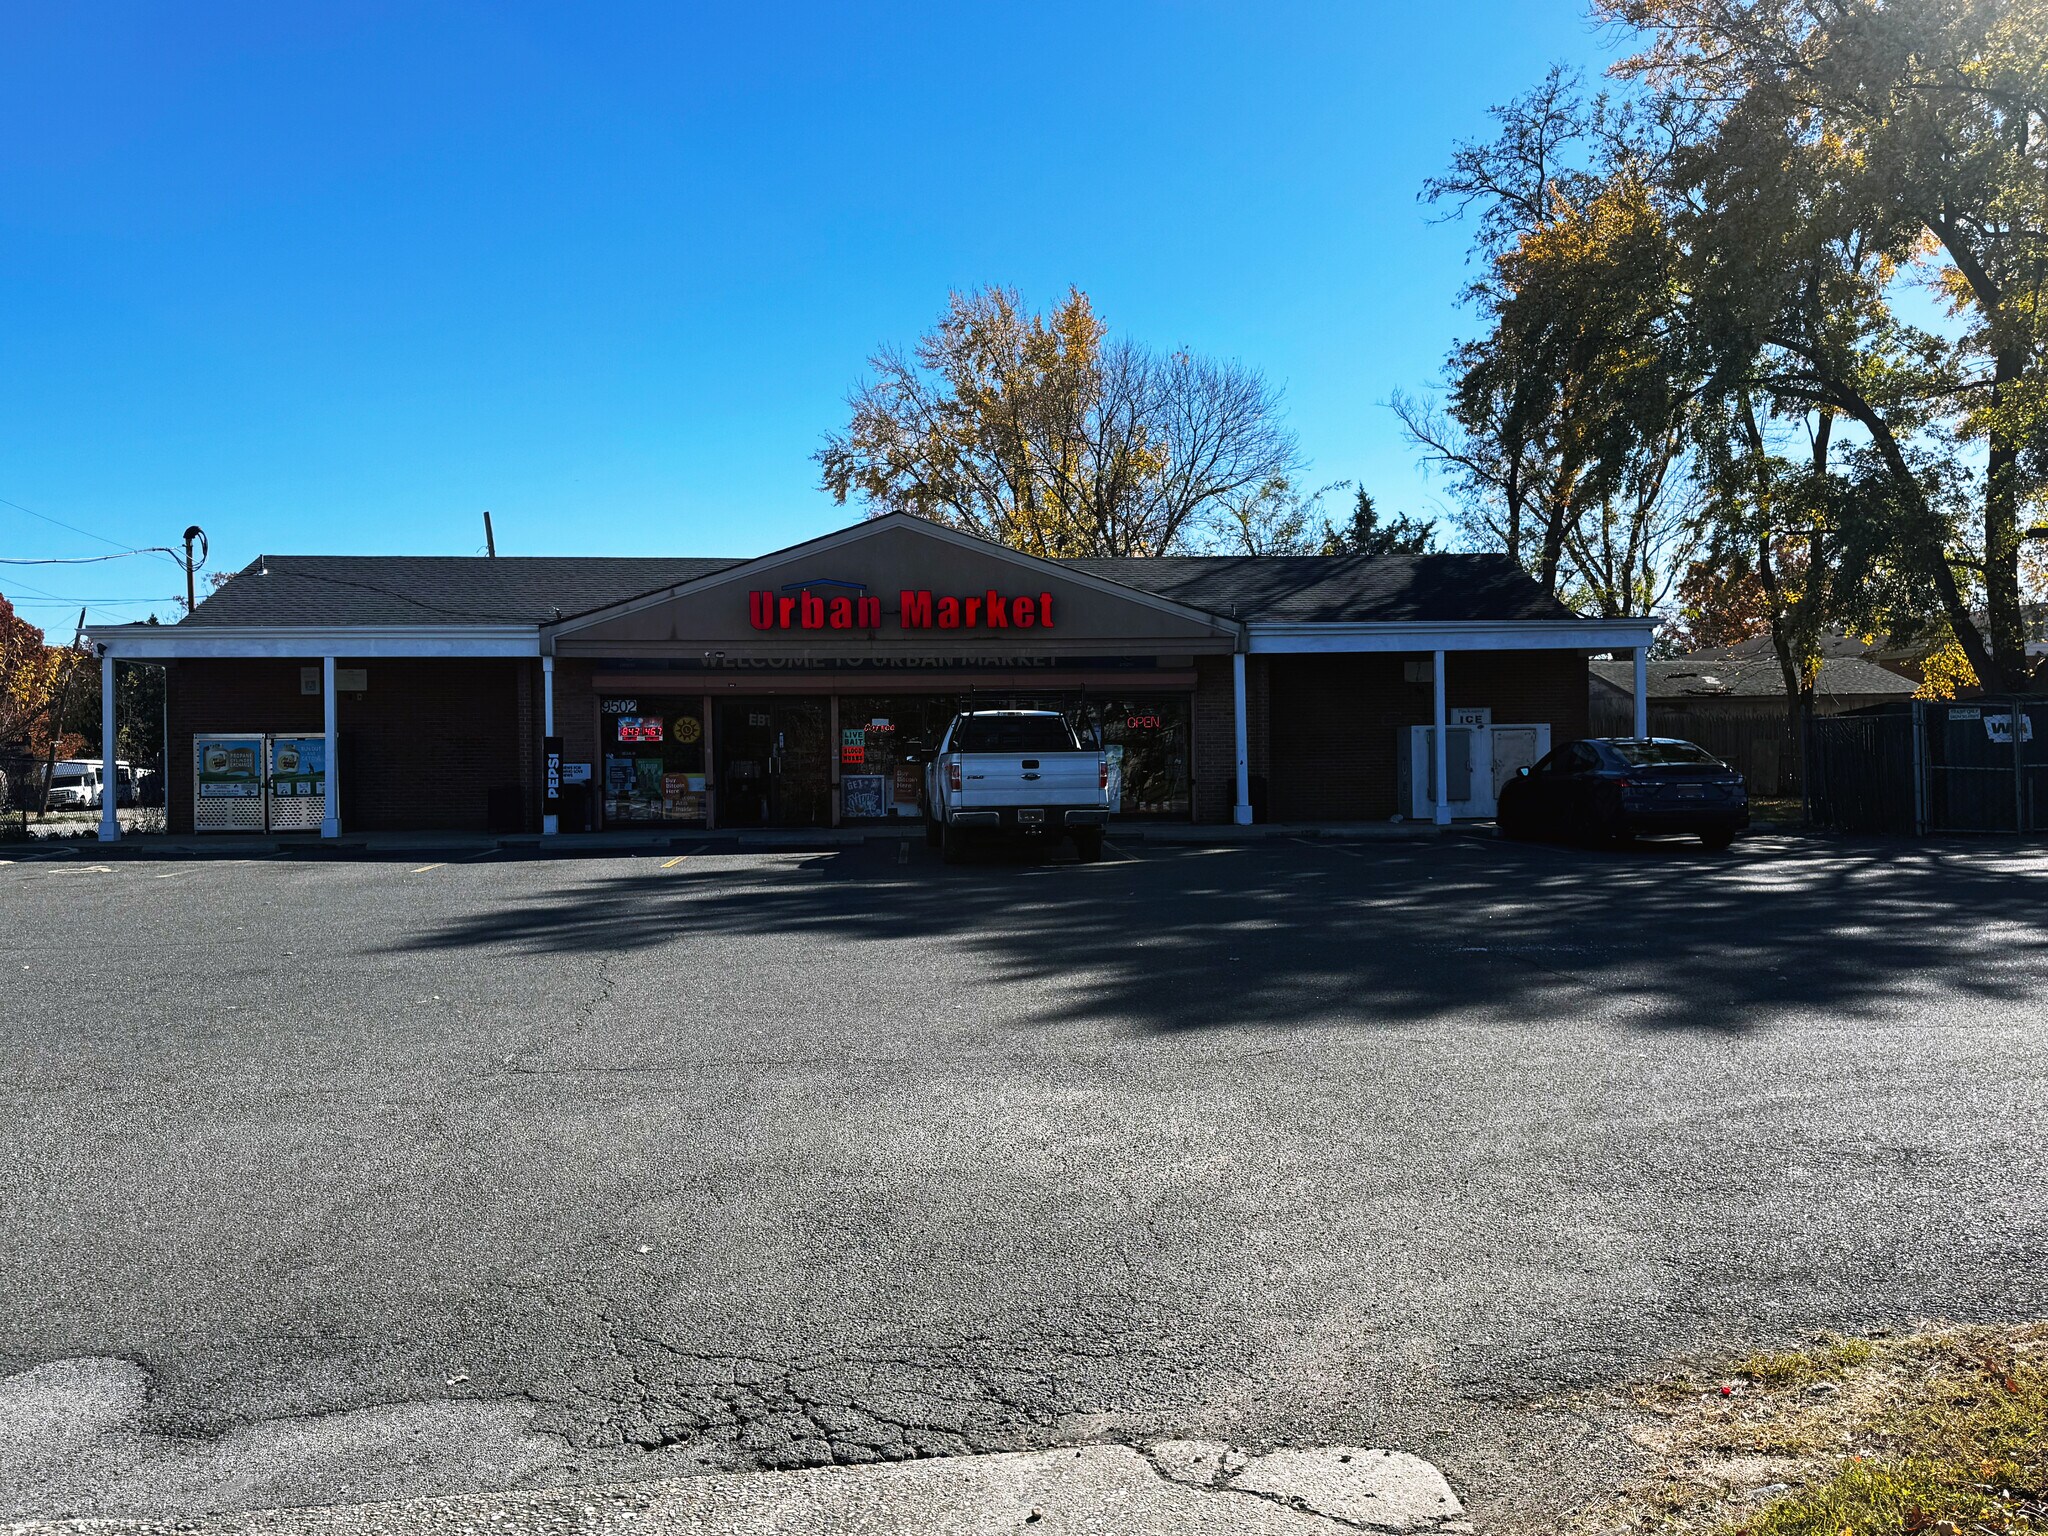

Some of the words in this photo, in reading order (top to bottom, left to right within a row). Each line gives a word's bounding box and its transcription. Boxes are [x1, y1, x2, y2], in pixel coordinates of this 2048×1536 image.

[749, 590, 881, 630] Urban
[900, 590, 1054, 630] Market
[701, 656, 825, 669] WELCOME
[836, 656, 864, 668] TO
[872, 655, 953, 668] URBAN
[961, 655, 1057, 668] MARKET
[602, 700, 637, 713] 9502
[1127, 716, 1161, 729] OPEN
[1460, 715, 1483, 723] ICE
[622, 727, 640, 736] 843
[547, 753, 560, 799] PEPSI
